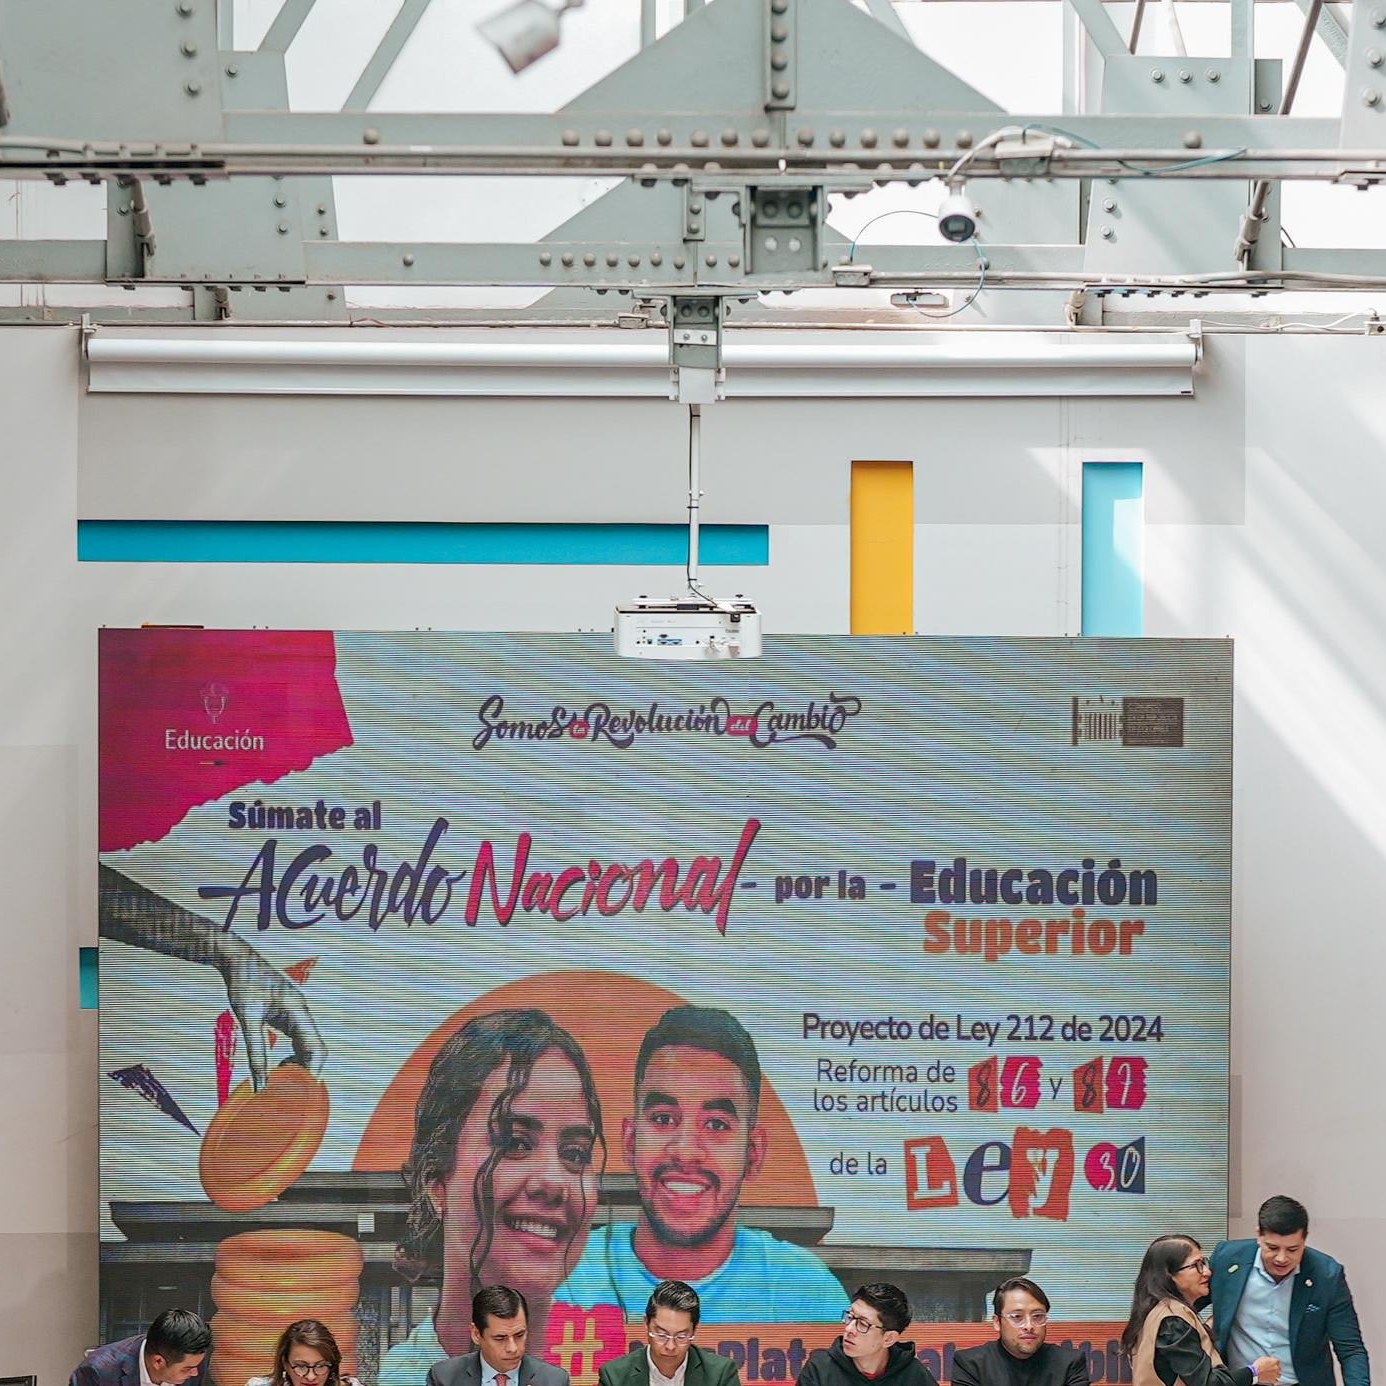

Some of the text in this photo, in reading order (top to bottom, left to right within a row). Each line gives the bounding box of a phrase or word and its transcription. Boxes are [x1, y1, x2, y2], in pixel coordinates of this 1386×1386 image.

[586, 696, 730, 749] Revolución
[750, 691, 861, 749] Cambio
[164, 729, 265, 751] Educación
[228, 801, 381, 830] Súmate al
[465, 818, 761, 936] Nacional
[775, 873, 832, 904] por
[838, 870, 866, 900] la
[911, 858, 1157, 905] Educación
[923, 909, 1144, 962] Superior
[803, 1013, 1164, 1046] Proyecto de Ley 212 de 2024
[817, 1058, 955, 1083] Reforma de
[813, 1088, 958, 1113] los artículos
[1049, 1078, 1063, 1100] y
[829, 1153, 859, 1175] de
[867, 1153, 887, 1175] la
[909, 1140, 1060, 1217] Ley
